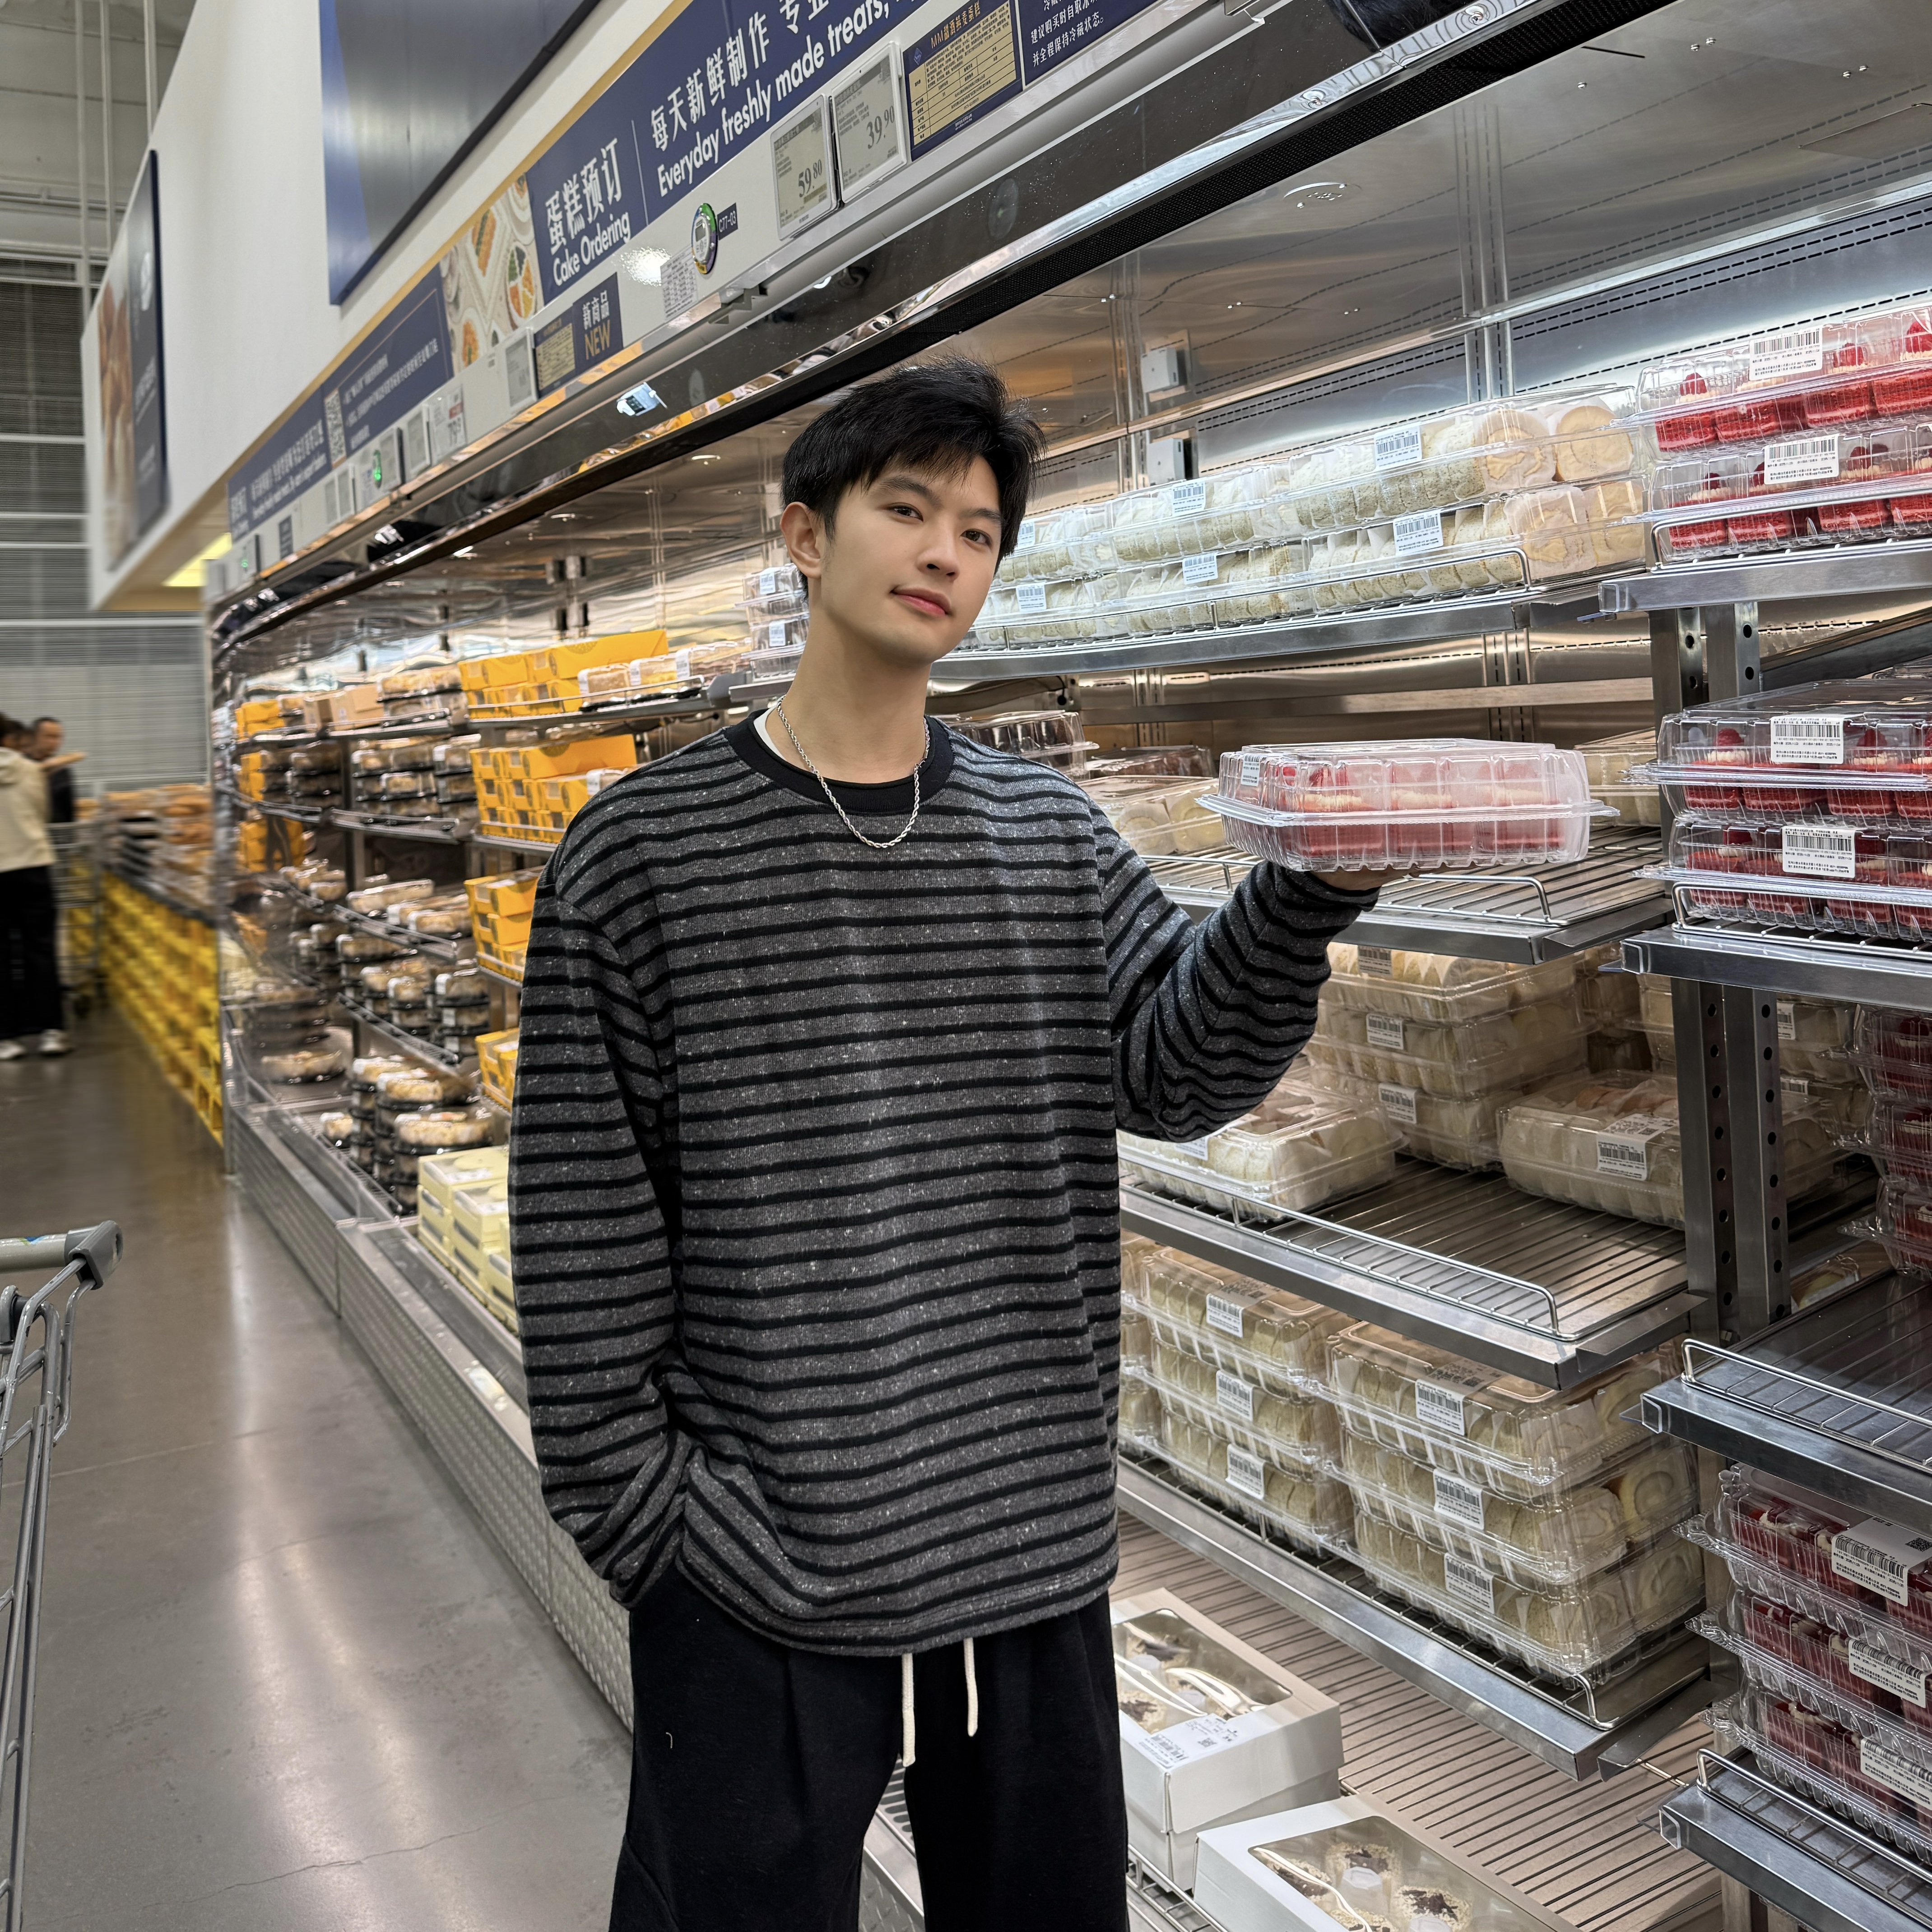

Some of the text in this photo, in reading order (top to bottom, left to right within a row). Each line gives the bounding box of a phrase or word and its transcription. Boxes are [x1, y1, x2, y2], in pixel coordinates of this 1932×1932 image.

[1032, 11, 1104, 67] 并全程保持冷藏状态。
[651, 11, 769, 151] 每天新鲜制作
[658, 129, 719, 197] Everyday
[722, 79, 771, 144] freshly
[776, 35, 824, 102] made
[827, 0, 889, 57] treats,
[866, 105, 895, 149] 39.90
[545, 138, 622, 255] 蛋糕预订
[799, 159, 822, 197] 59.80
[553, 212, 631, 286] Cake Ordering
[719, 210, 736, 232] C77-03
[585, 320, 610, 360] NEW
